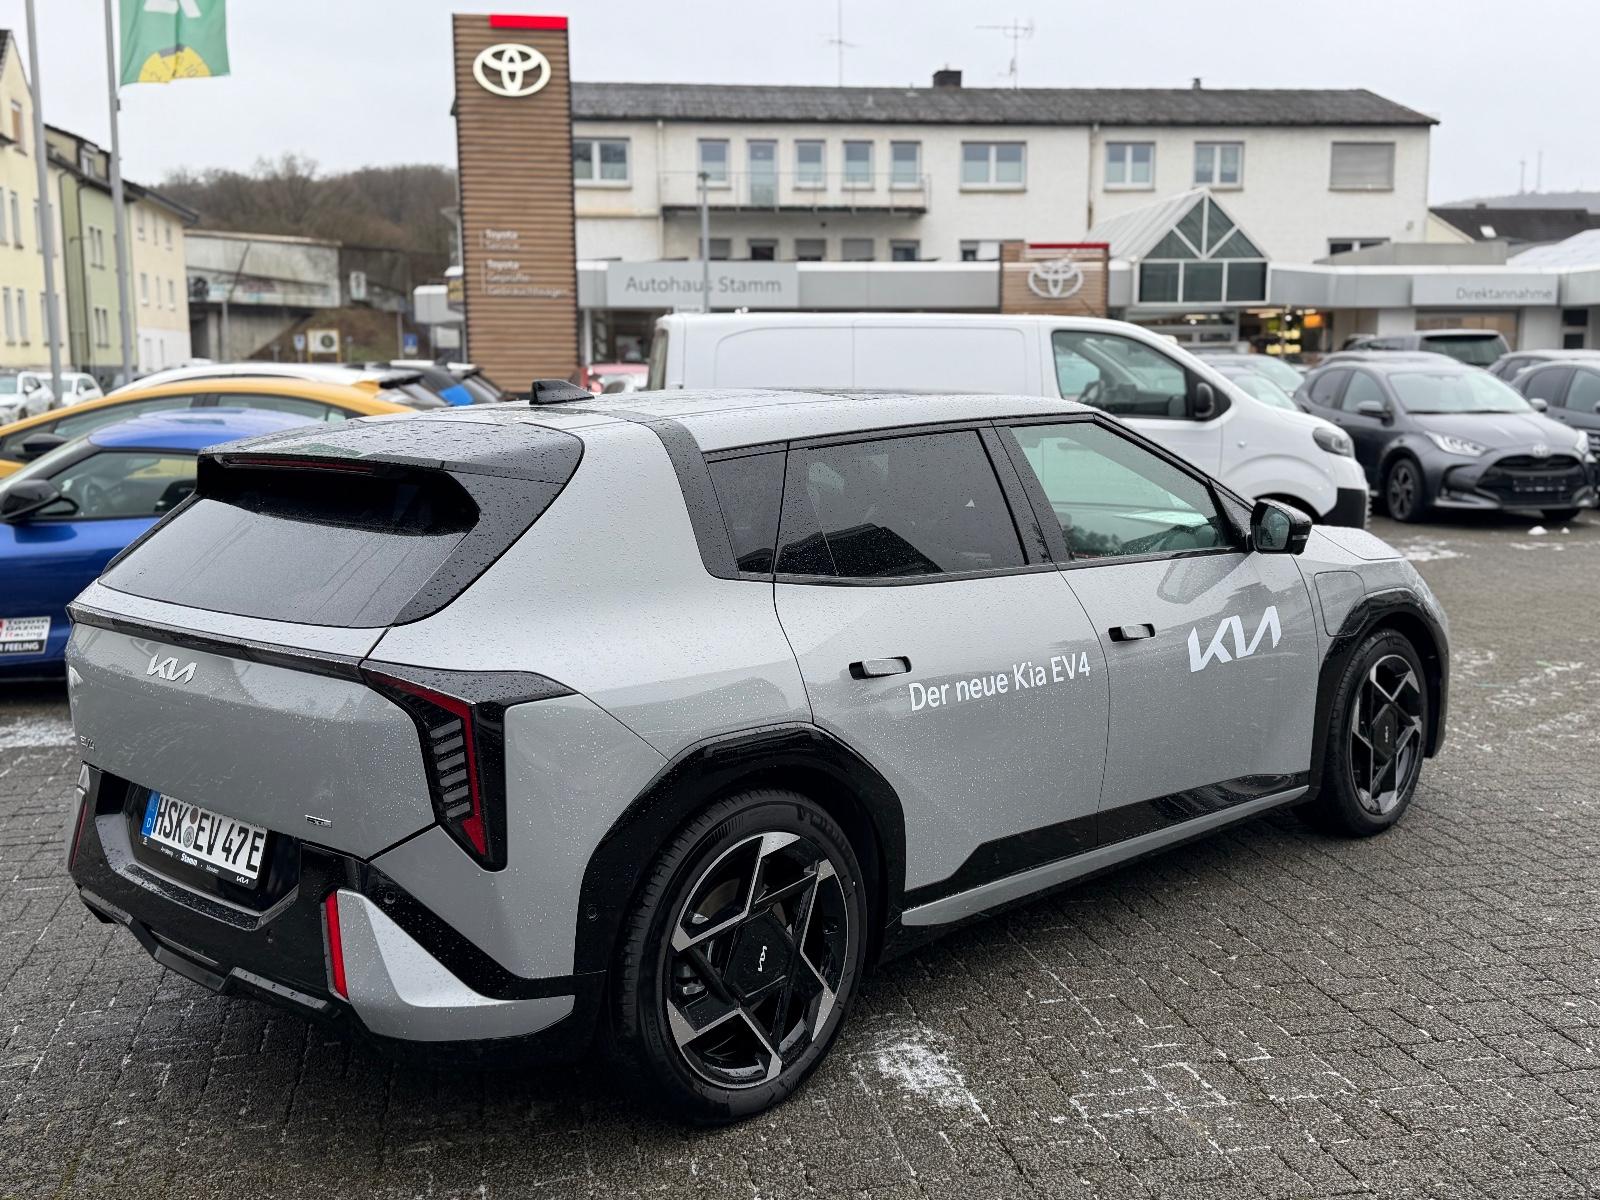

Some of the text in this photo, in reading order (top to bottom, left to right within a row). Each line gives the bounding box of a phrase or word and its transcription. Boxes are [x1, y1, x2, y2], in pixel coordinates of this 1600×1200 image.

[718, 276, 782, 294] Stamm
[1455, 286, 1553, 301] Direktannahme
[908, 651, 1091, 712] Der neue Kia EV4
[152, 796, 189, 844] HSK
[193, 811, 223, 856] EV
[221, 823, 264, 873] 47E
